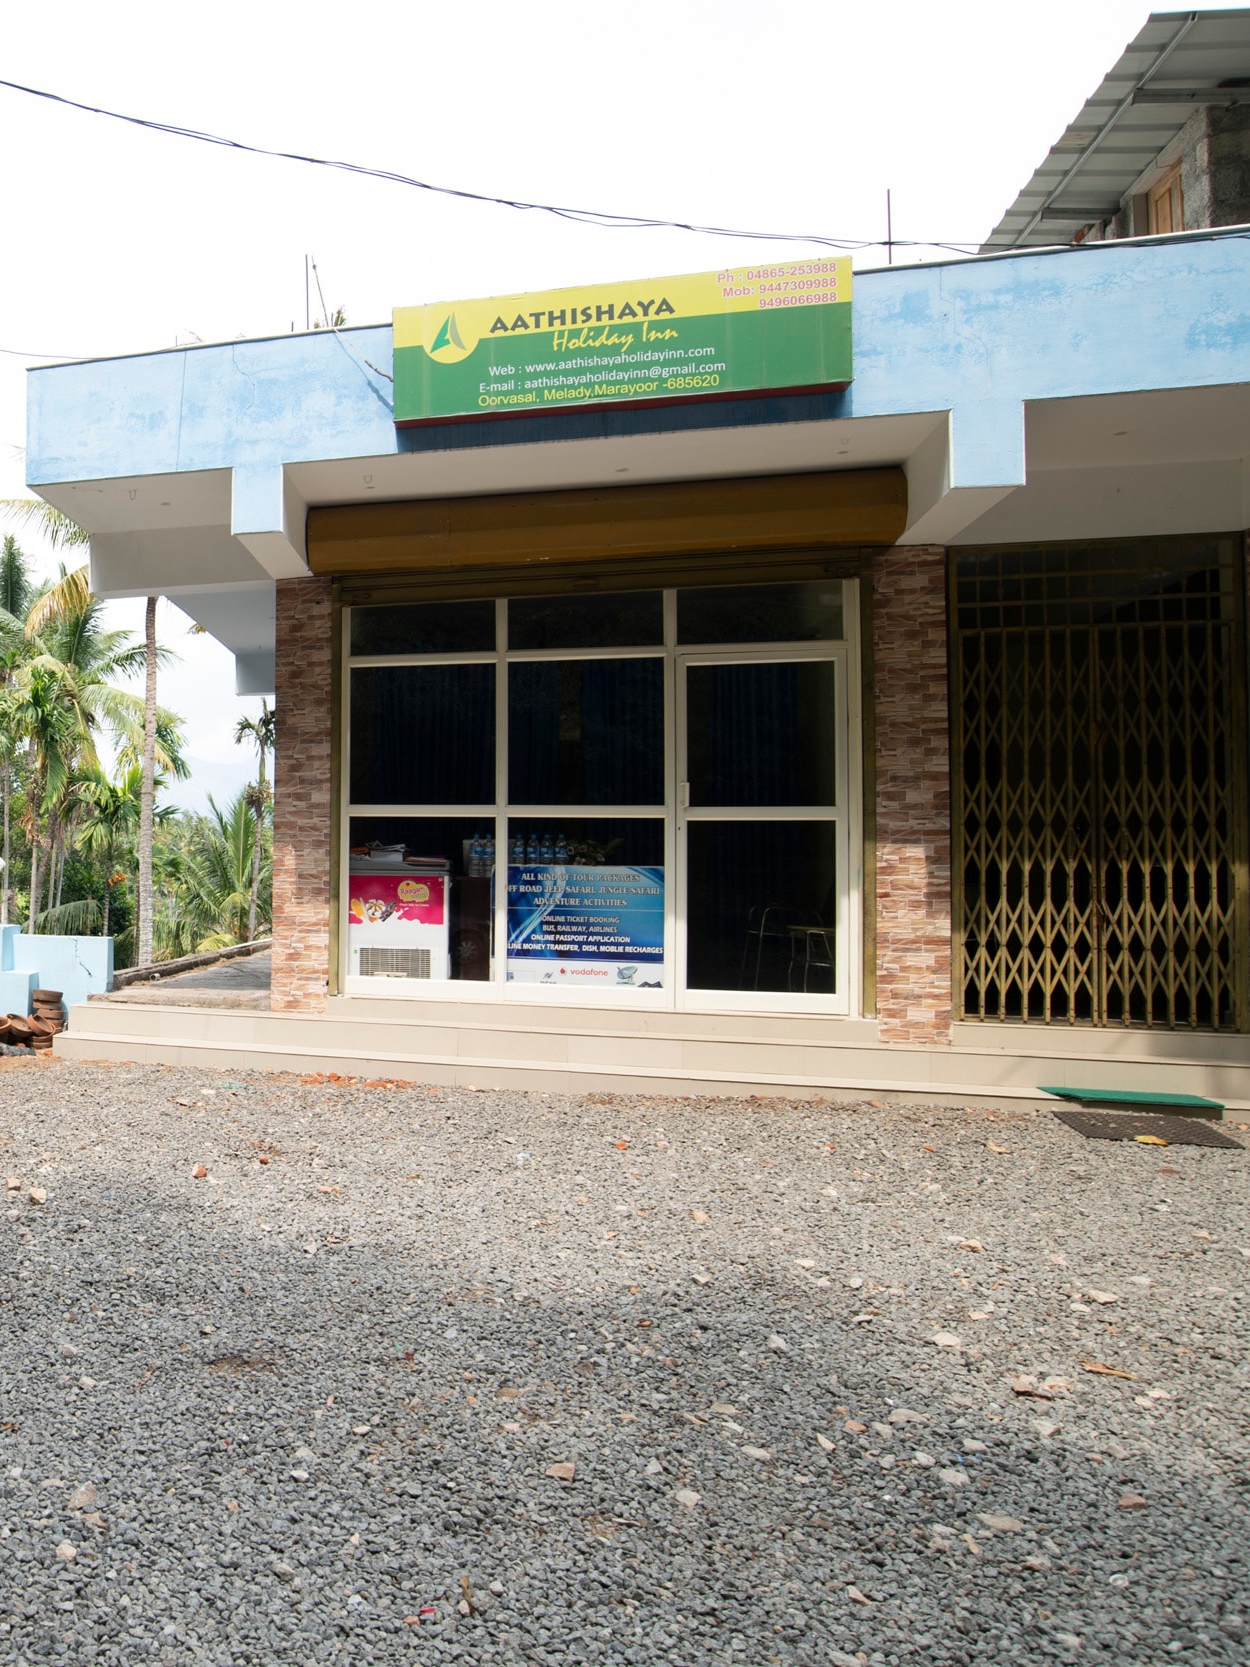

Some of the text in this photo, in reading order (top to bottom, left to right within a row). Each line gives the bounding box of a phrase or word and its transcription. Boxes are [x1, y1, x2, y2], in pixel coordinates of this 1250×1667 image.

[717, 271, 735, 284] Ph
[746, 262, 837, 282] 04865-253988
[722, 276, 838, 298] Mob: 9447309988
[758, 292, 838, 309] 9496066988
[489, 297, 676, 334] AATHISHAYA
[553, 321, 679, 353] Holiday Inn
[488, 363, 516, 376] Web
[525, 345, 715, 375] www.aathishayaholidayinn.com
[479, 378, 515, 393] E-mail
[524, 360, 726, 392] aathishayaholidayinn@gmail.com
[521, 872, 641, 882] ALL KIND OF TOUR PACKAGES
[519, 884, 542, 893] ROAD
[544, 884, 562, 893] JEEP
[599, 886, 628, 894] JUNGLE
[630, 887, 660, 895] SAFARI
[533, 897, 627, 907] ADVENTURE ACTIVITIES
[566, 915, 588, 923] TICKET
[587, 935, 630, 943] APPLICATION
[522, 943, 546, 951] MONEY
[624, 946, 663, 954] RECHARGES
[570, 967, 609, 977] vodafone
